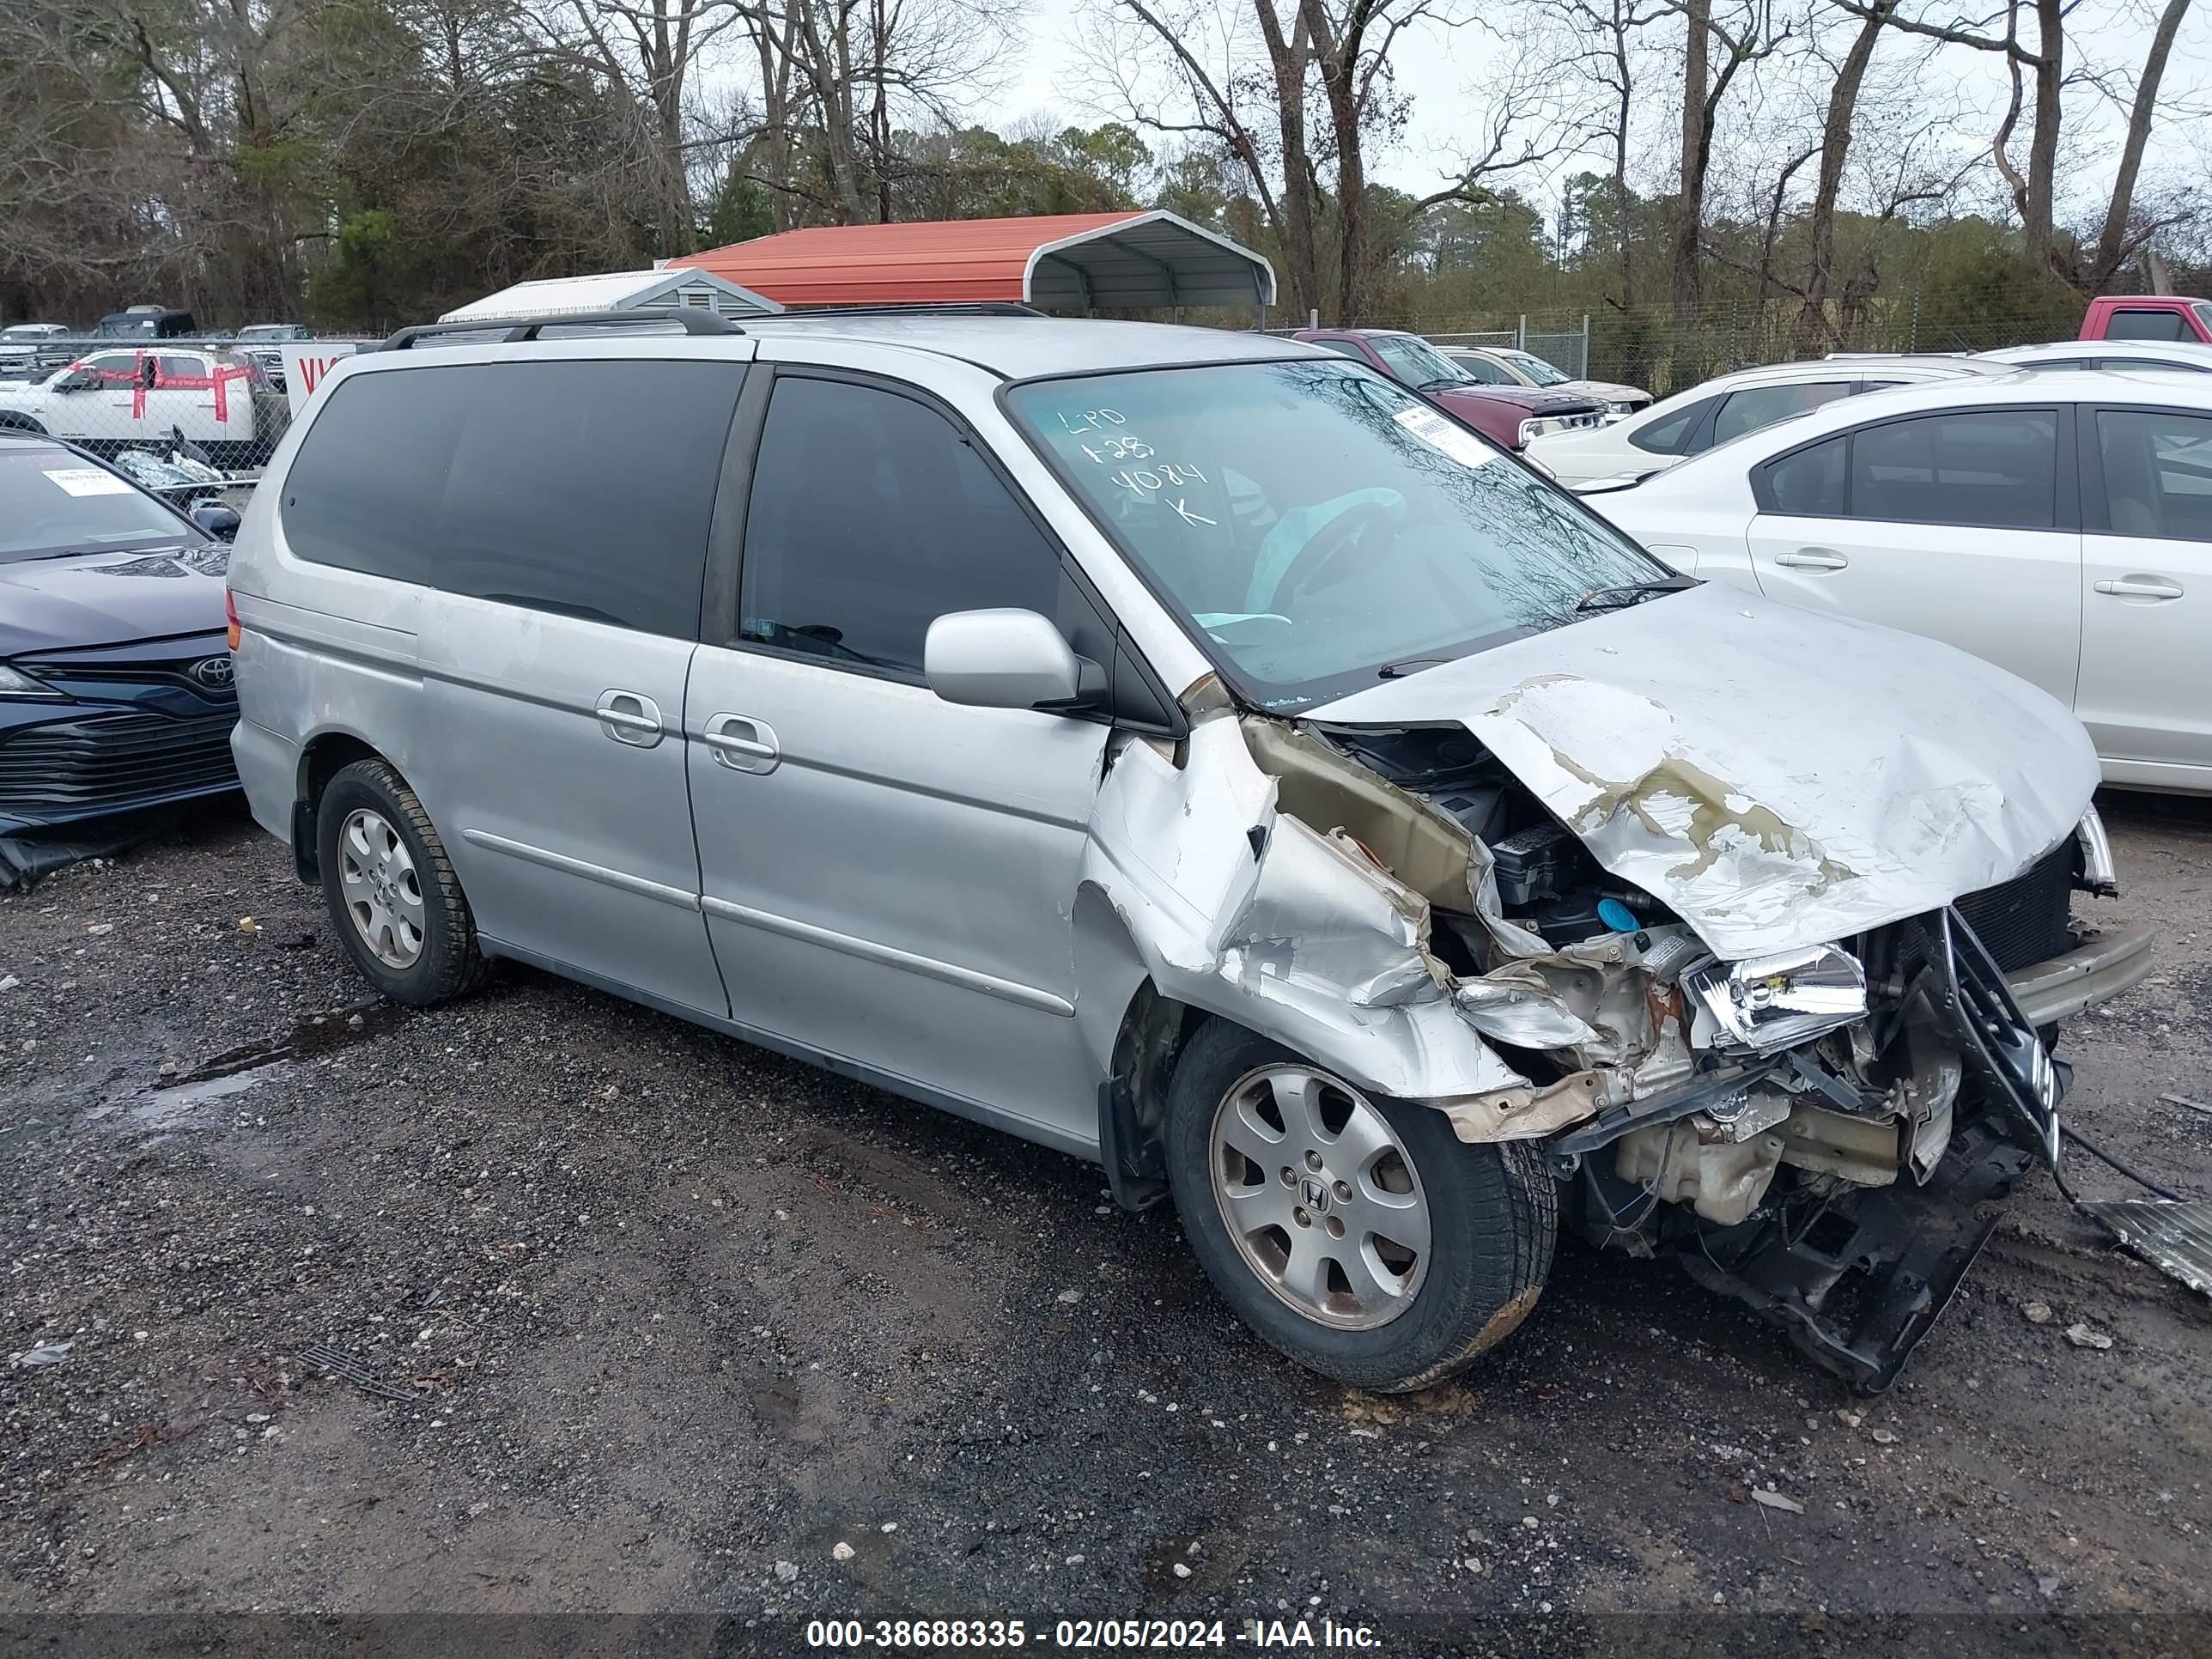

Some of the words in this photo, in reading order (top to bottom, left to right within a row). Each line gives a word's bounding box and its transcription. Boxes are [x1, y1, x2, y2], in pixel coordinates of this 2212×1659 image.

[1081, 436, 1155, 465] 1-28
[1110, 463, 1209, 497] 4084
[1164, 497, 1218, 528] K
